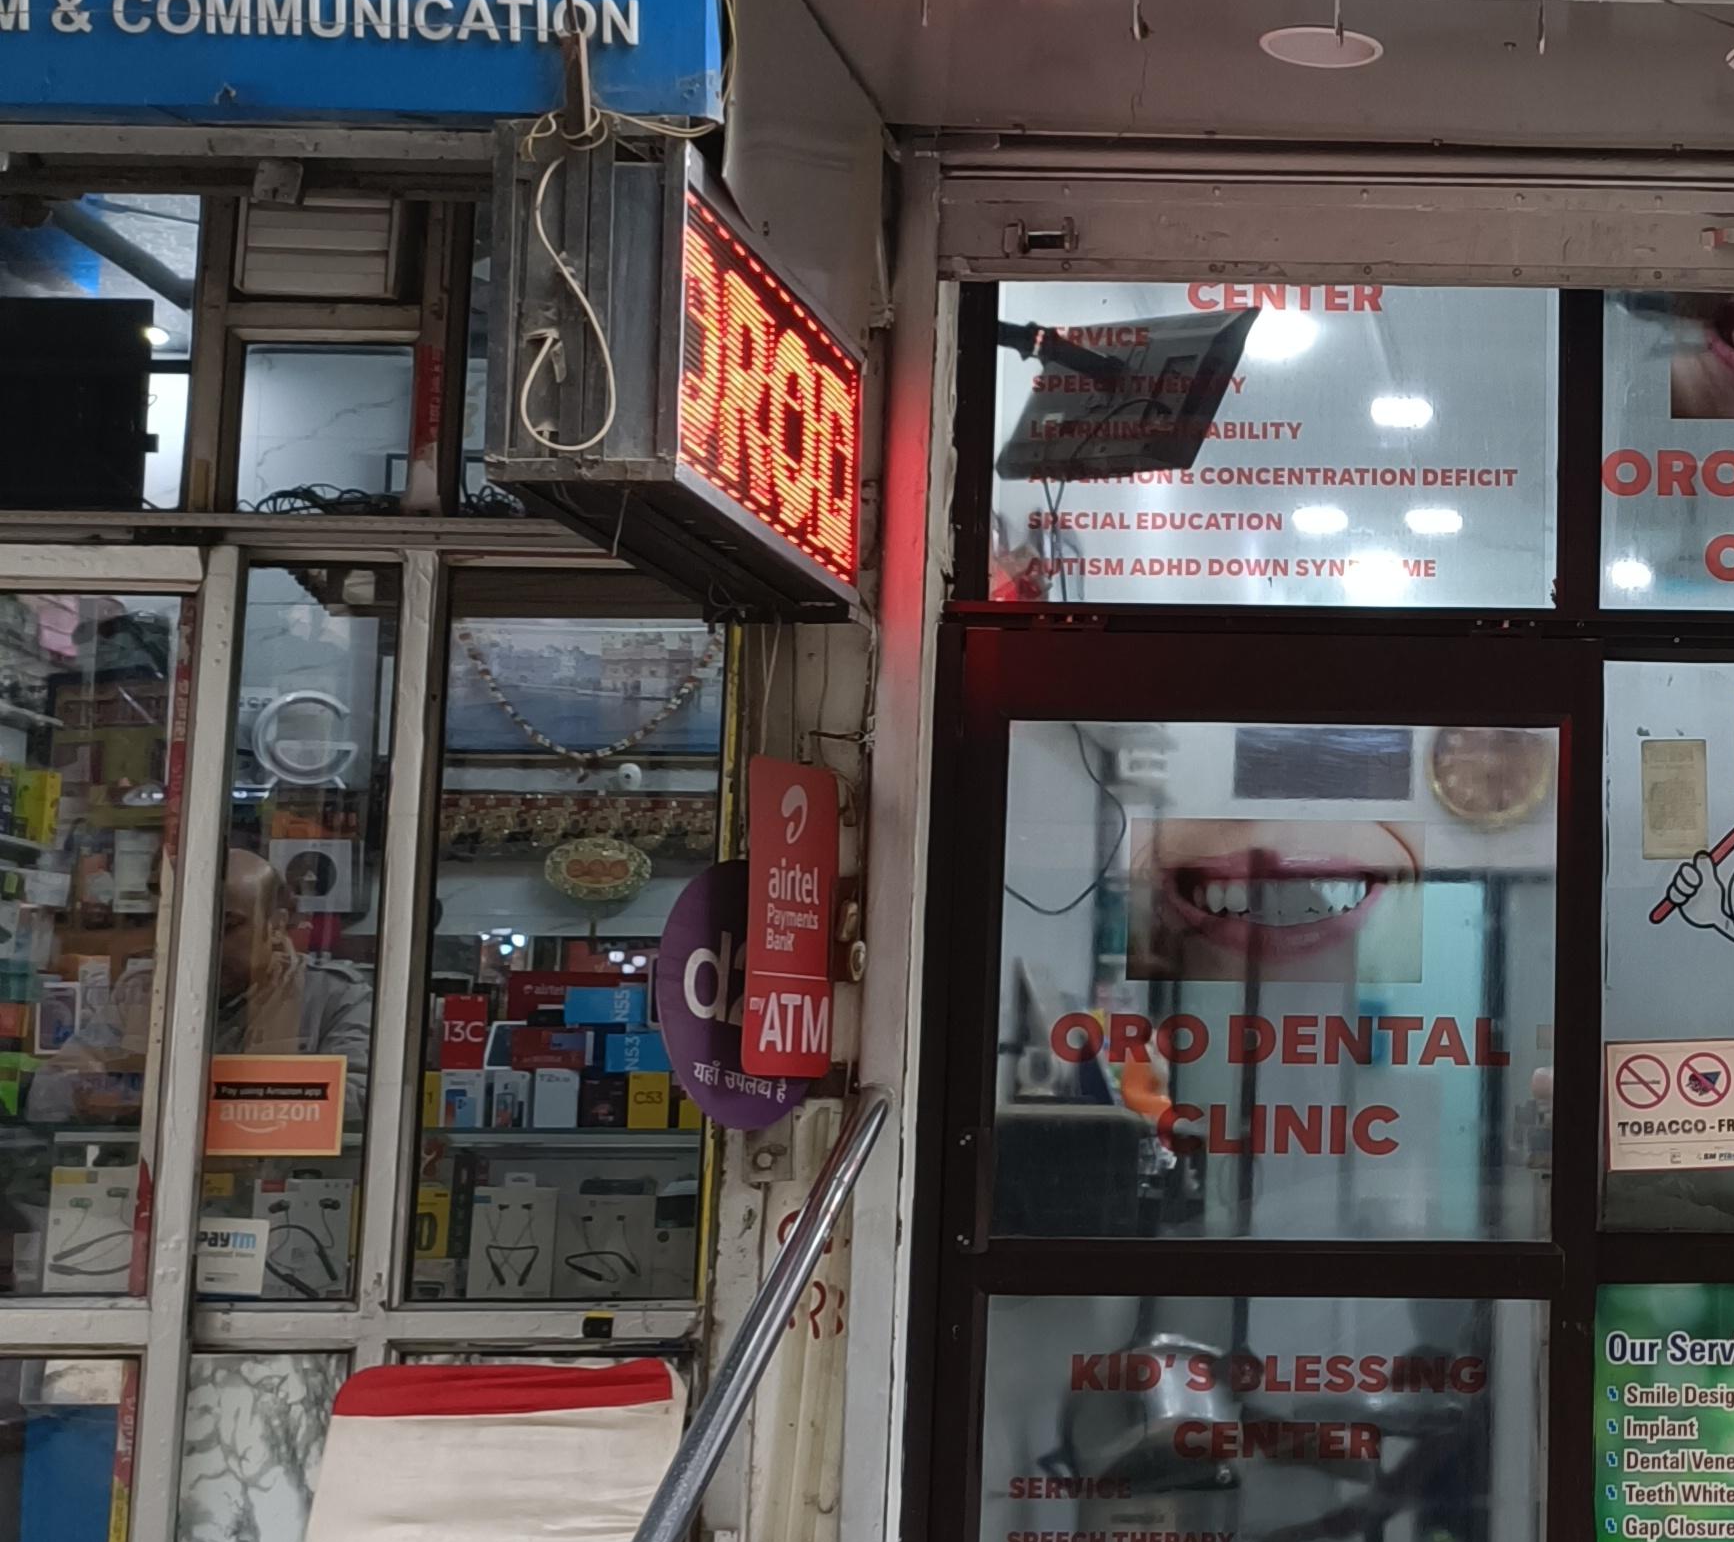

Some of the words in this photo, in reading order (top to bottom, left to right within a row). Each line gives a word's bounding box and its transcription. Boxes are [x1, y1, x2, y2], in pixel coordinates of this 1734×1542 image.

[1187, 282, 1384, 313] CENTER
[1201, 467, 1417, 488] CONCENTRATION
[1422, 468, 1518, 488] DEFICIT
[1027, 511, 1131, 531] SPECIAL
[1136, 512, 1284, 532] EDUCATION
[1026, 558, 1125, 578] AUTISM
[1130, 559, 1203, 578] ADHD
[1208, 559, 1289, 578] DOWN
[767, 860, 819, 905] airtel
[766, 903, 819, 931] Payments
[765, 929, 795, 952] Bank
[615, 990, 630, 1021] N55
[443, 1021, 485, 1042] 13C
[758, 992, 830, 1054] ATM
[1050, 1013, 1210, 1065] ORO
[1228, 1014, 1511, 1067] DENTAL
[625, 1035, 640, 1070] N53
[220, 1103, 320, 1122] amazon
[1157, 1104, 1400, 1156] CLINIC
[1607, 1333, 1660, 1366] Our
[1230, 1354, 1488, 1395] BLESSING
[1625, 1385, 1678, 1406] Smile
[1173, 1420, 1381, 1460] CENTER
[1625, 1418, 1698, 1441] Implant
[1625, 1452, 1686, 1472] Dental
[1008, 1477, 1133, 1500] SERVICE
[1624, 1484, 1677, 1505] Teeth
[1624, 1518, 1660, 1541] Gap
